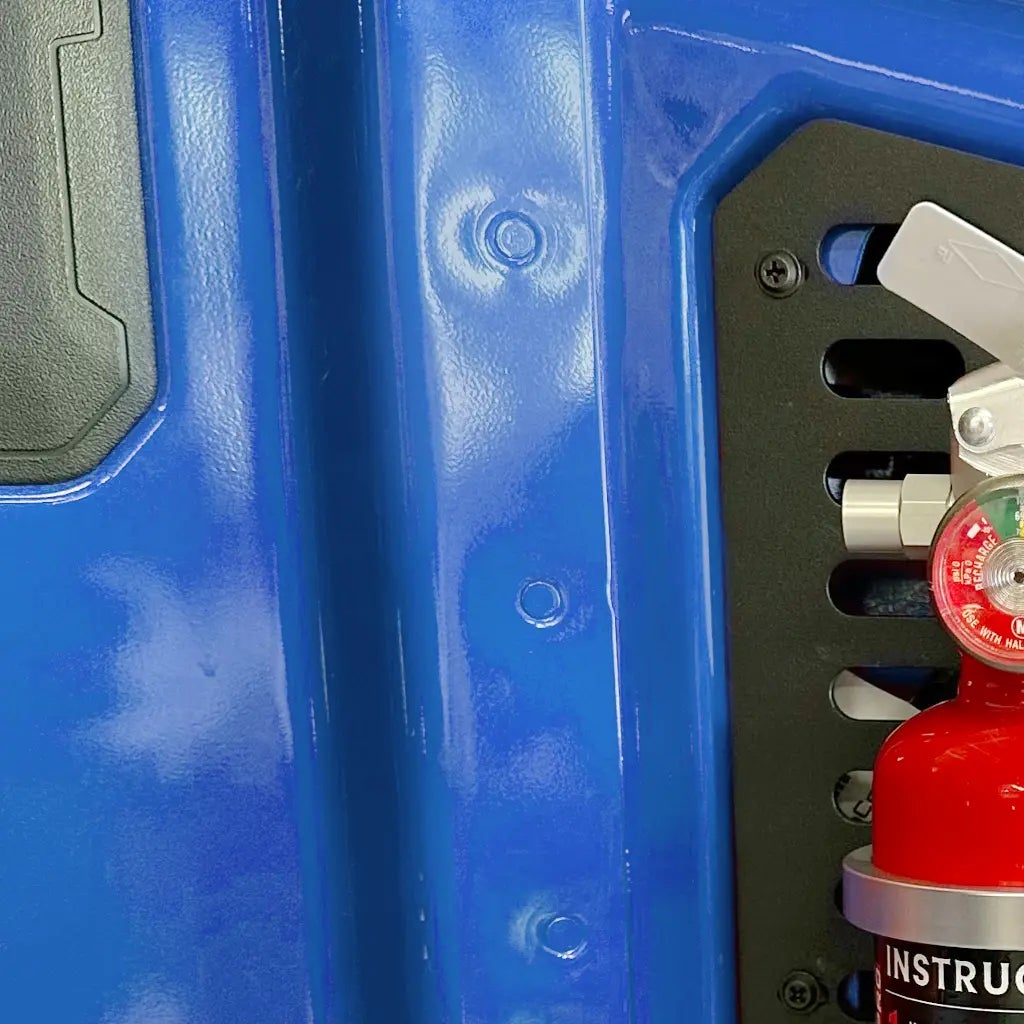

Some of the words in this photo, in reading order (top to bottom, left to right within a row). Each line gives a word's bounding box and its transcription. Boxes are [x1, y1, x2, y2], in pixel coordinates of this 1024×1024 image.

[973, 534, 998, 591] RECHARGE
[962, 608, 979, 628] USE
[980, 625, 1002, 645] WITH
